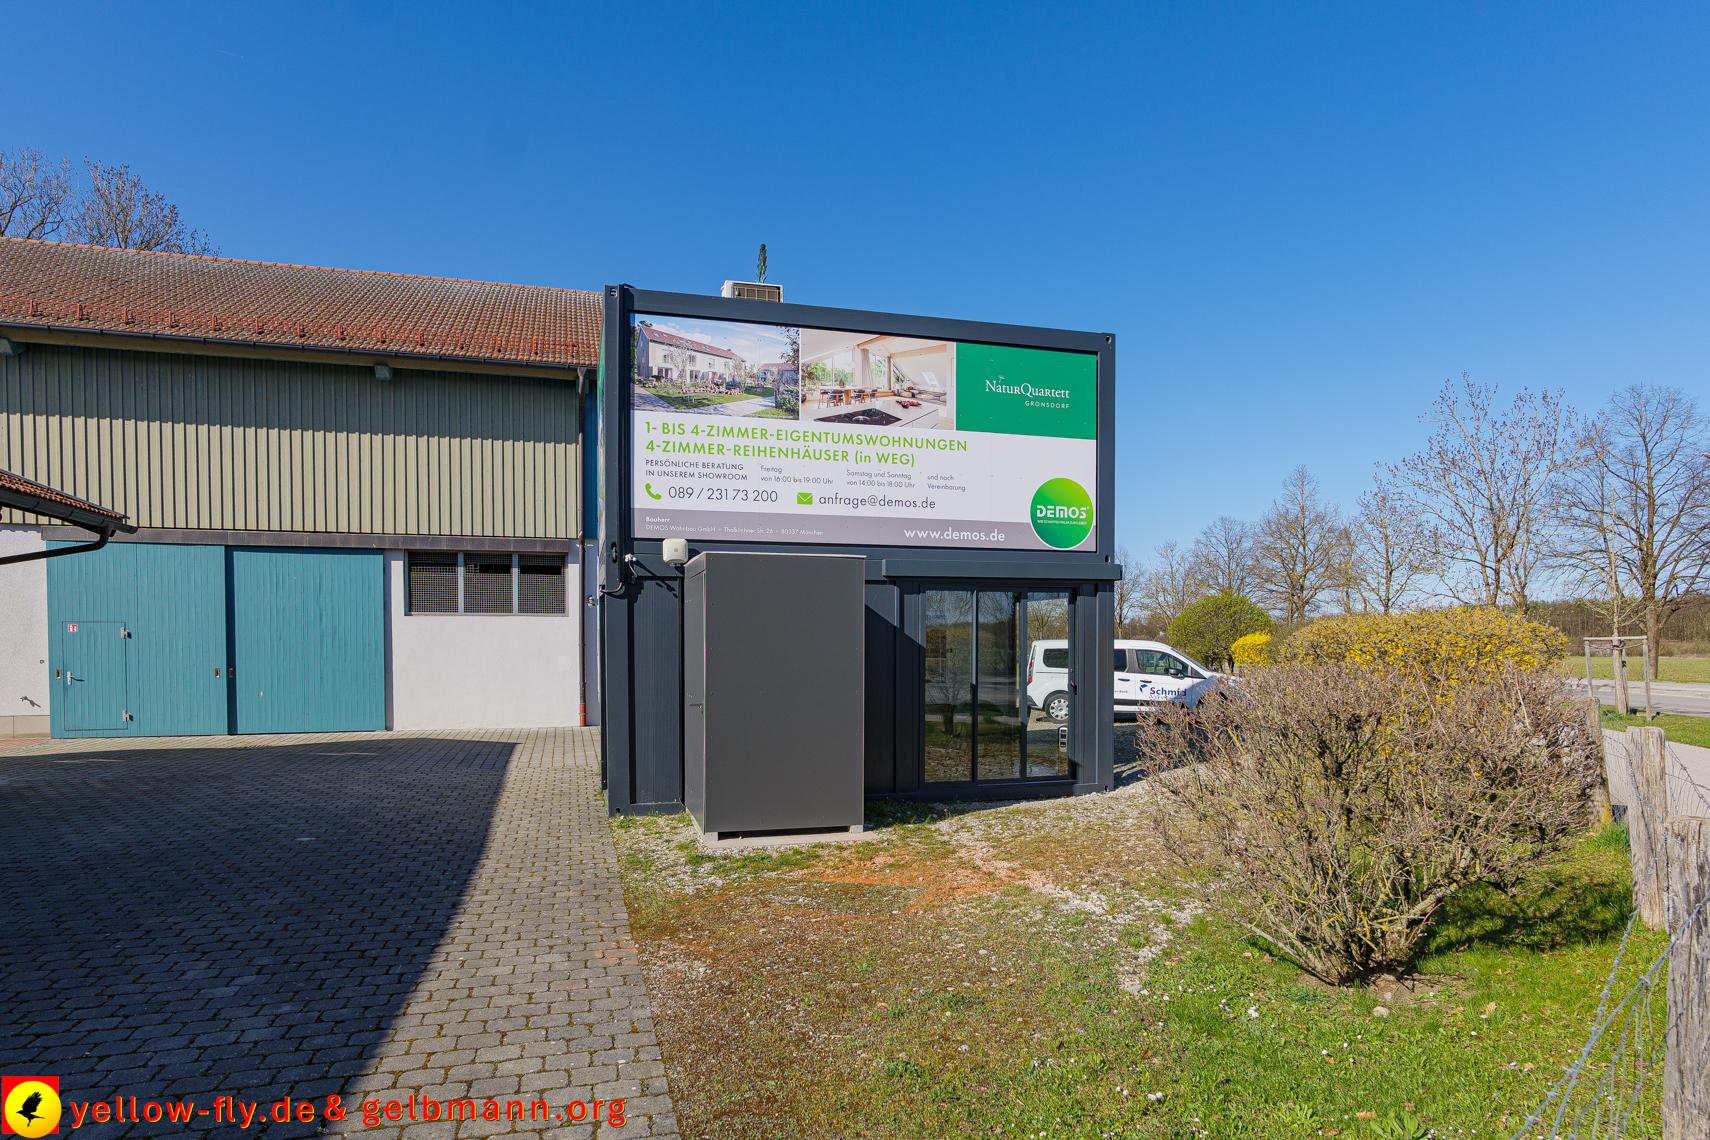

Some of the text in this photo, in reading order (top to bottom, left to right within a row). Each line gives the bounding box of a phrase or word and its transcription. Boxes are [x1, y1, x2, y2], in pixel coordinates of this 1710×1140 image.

[1024, 400, 1070, 409] GRONSDORF
[662, 422, 685, 435] BIS
[690, 424, 968, 452] 4-ZIMMER-EIGENTUMSWOHNUNGEN
[645, 440, 915, 468] 4-ZIMMER-REIHENHÄUSER (in WEG)
[645, 458, 744, 471] PERSÖNLICHE BERATUNG
[760, 465, 783, 475] Freitag
[645, 469, 748, 481] IN UNSEREM SHOWROOM
[773, 475, 792, 483] 16:00
[793, 476, 803, 484] bis
[803, 476, 822, 485] 19:00
[822, 477, 834, 485] Uhr
[846, 470, 912, 481] Samstag und Sonntag
[927, 473, 955, 482] und nach
[858, 479, 876, 487] 14:00
[876, 480, 886, 488] bis
[886, 480, 903, 489] 18:00
[904, 481, 916, 489] Uhr
[927, 482, 966, 493] Vereinbarung
[668, 486, 694, 499] 089
[752, 489, 779, 503] 200
[818, 492, 937, 510] anfrage@demos.de
[1036, 505, 1087, 519] DEMOS
[645, 524, 669, 532] DEMOS
[670, 525, 697, 533] Wohnbau
[697, 525, 716, 533] GmbH
[904, 527, 1006, 542] www.demos.de
[1149, 686, 1187, 696] Schmid
